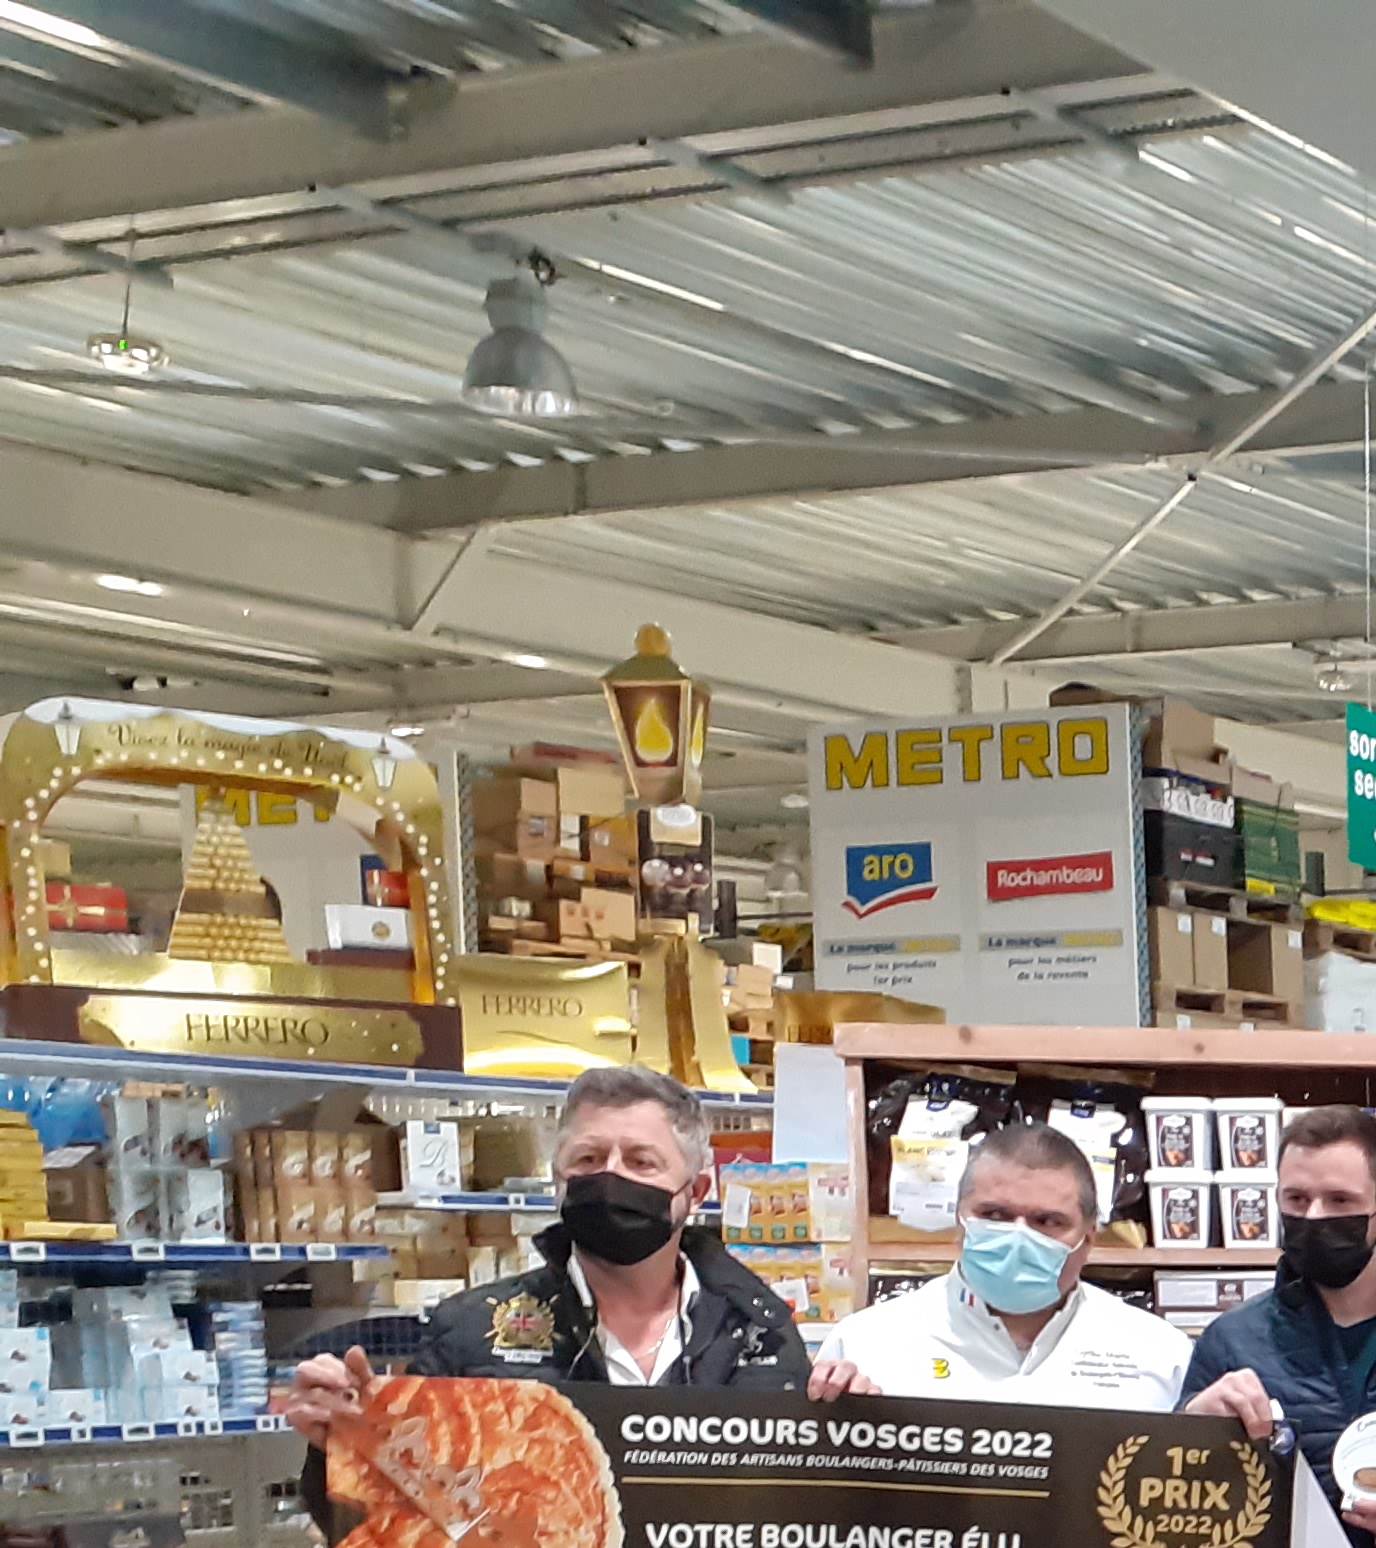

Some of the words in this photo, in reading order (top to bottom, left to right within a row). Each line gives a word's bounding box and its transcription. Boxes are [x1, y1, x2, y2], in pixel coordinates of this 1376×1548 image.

[825, 716, 1109, 791] METRO
[862, 852, 914, 881] aro
[997, 865, 1103, 888] Rochambeau
[988, 937, 1002, 947] La
[1006, 936, 1057, 948] marque
[892, 959, 937, 972] produits
[481, 995, 583, 1018] FERRERO
[185, 1013, 329, 1046] FERRERO
[620, 1414, 819, 1447] CONCOURS
[826, 1420, 964, 1453] VOSGES
[970, 1428, 1053, 1458] 2022
[624, 1449, 708, 1465] FÉDÉRATION
[710, 1452, 738, 1465] DES
[740, 1452, 803, 1468] ARTISANS
[969, 1463, 995, 1477] DES
[999, 1465, 1049, 1480] VOSGES
[1166, 1446, 1211, 1477] 1er
[1139, 1477, 1231, 1510] PRIX
[1155, 1514, 1213, 1535] 2022
